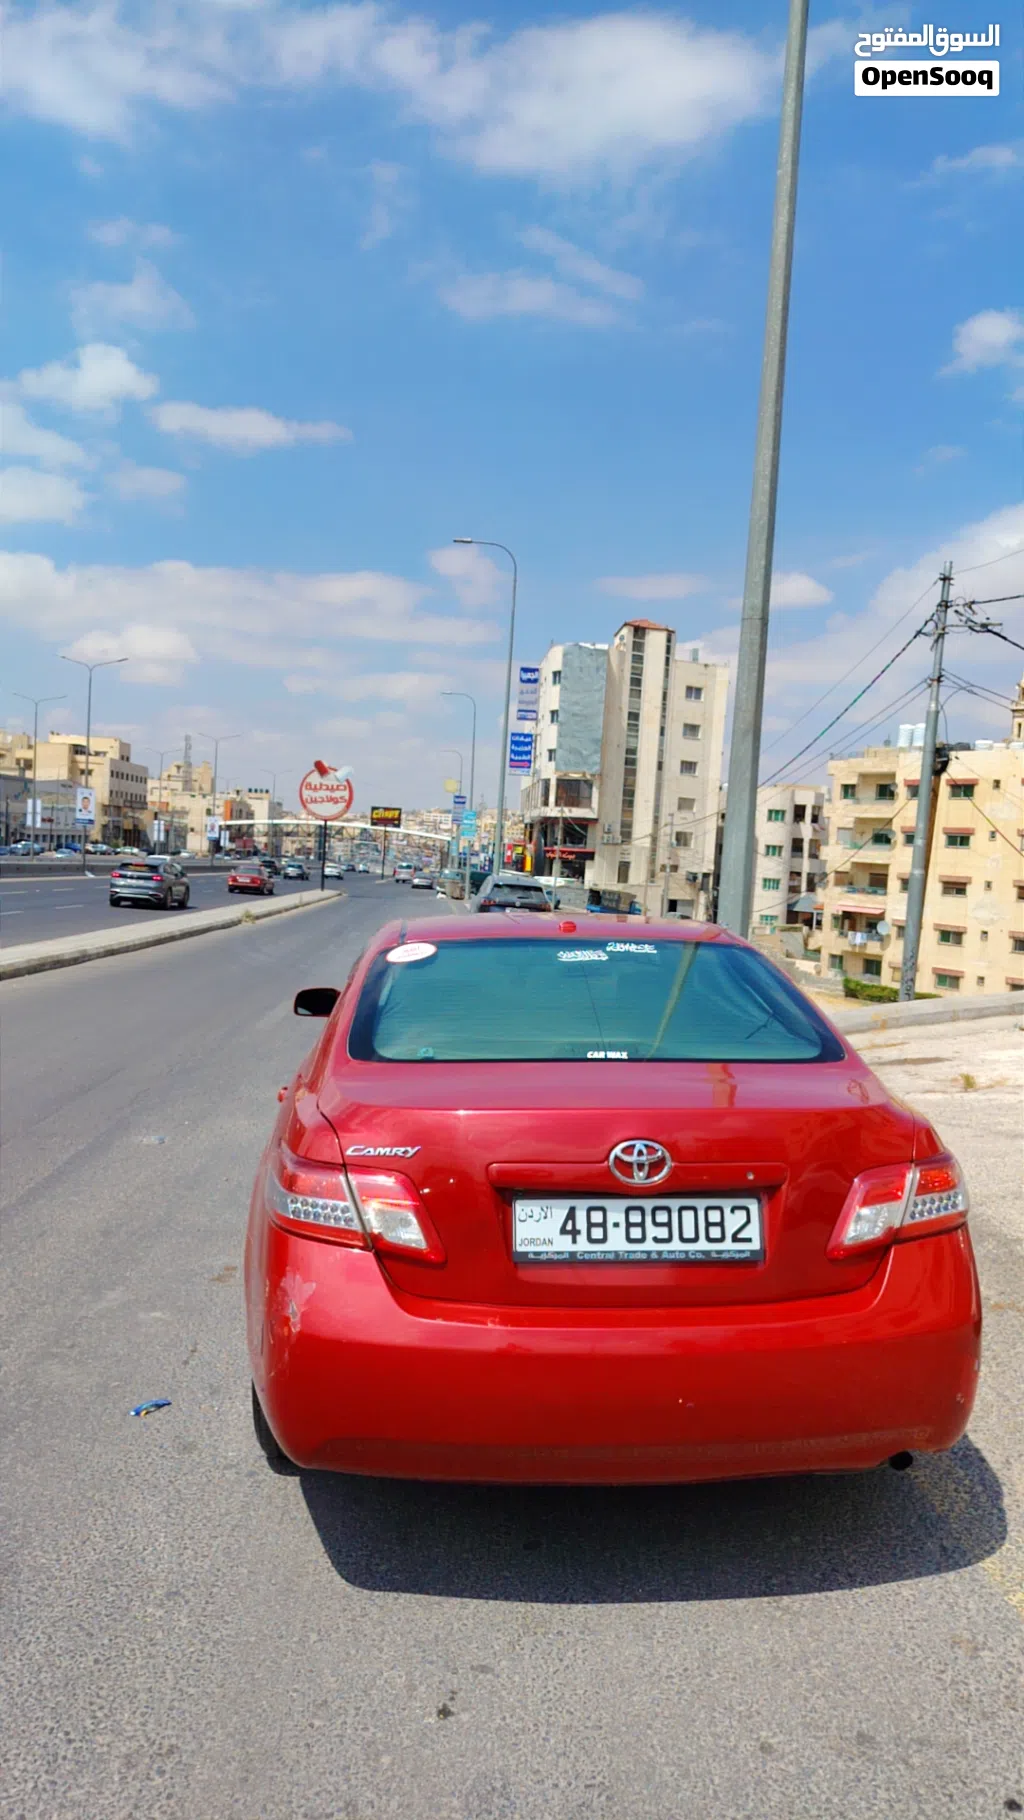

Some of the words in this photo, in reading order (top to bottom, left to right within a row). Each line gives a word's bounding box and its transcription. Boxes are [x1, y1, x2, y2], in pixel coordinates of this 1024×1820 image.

[305, 781, 347, 793] صيدلية
[305, 794, 347, 804] كولاجين
[586, 1050, 605, 1059] CAR
[345, 1145, 422, 1158] CAMRY
[518, 1237, 554, 1247] JORDAN
[576, 1251, 615, 1260] Central
[618, 1251, 647, 1260] Trade
[651, 1251, 659, 1260] &
[661, 1251, 686, 1260] Auto
[688, 1251, 706, 1260] Co.
